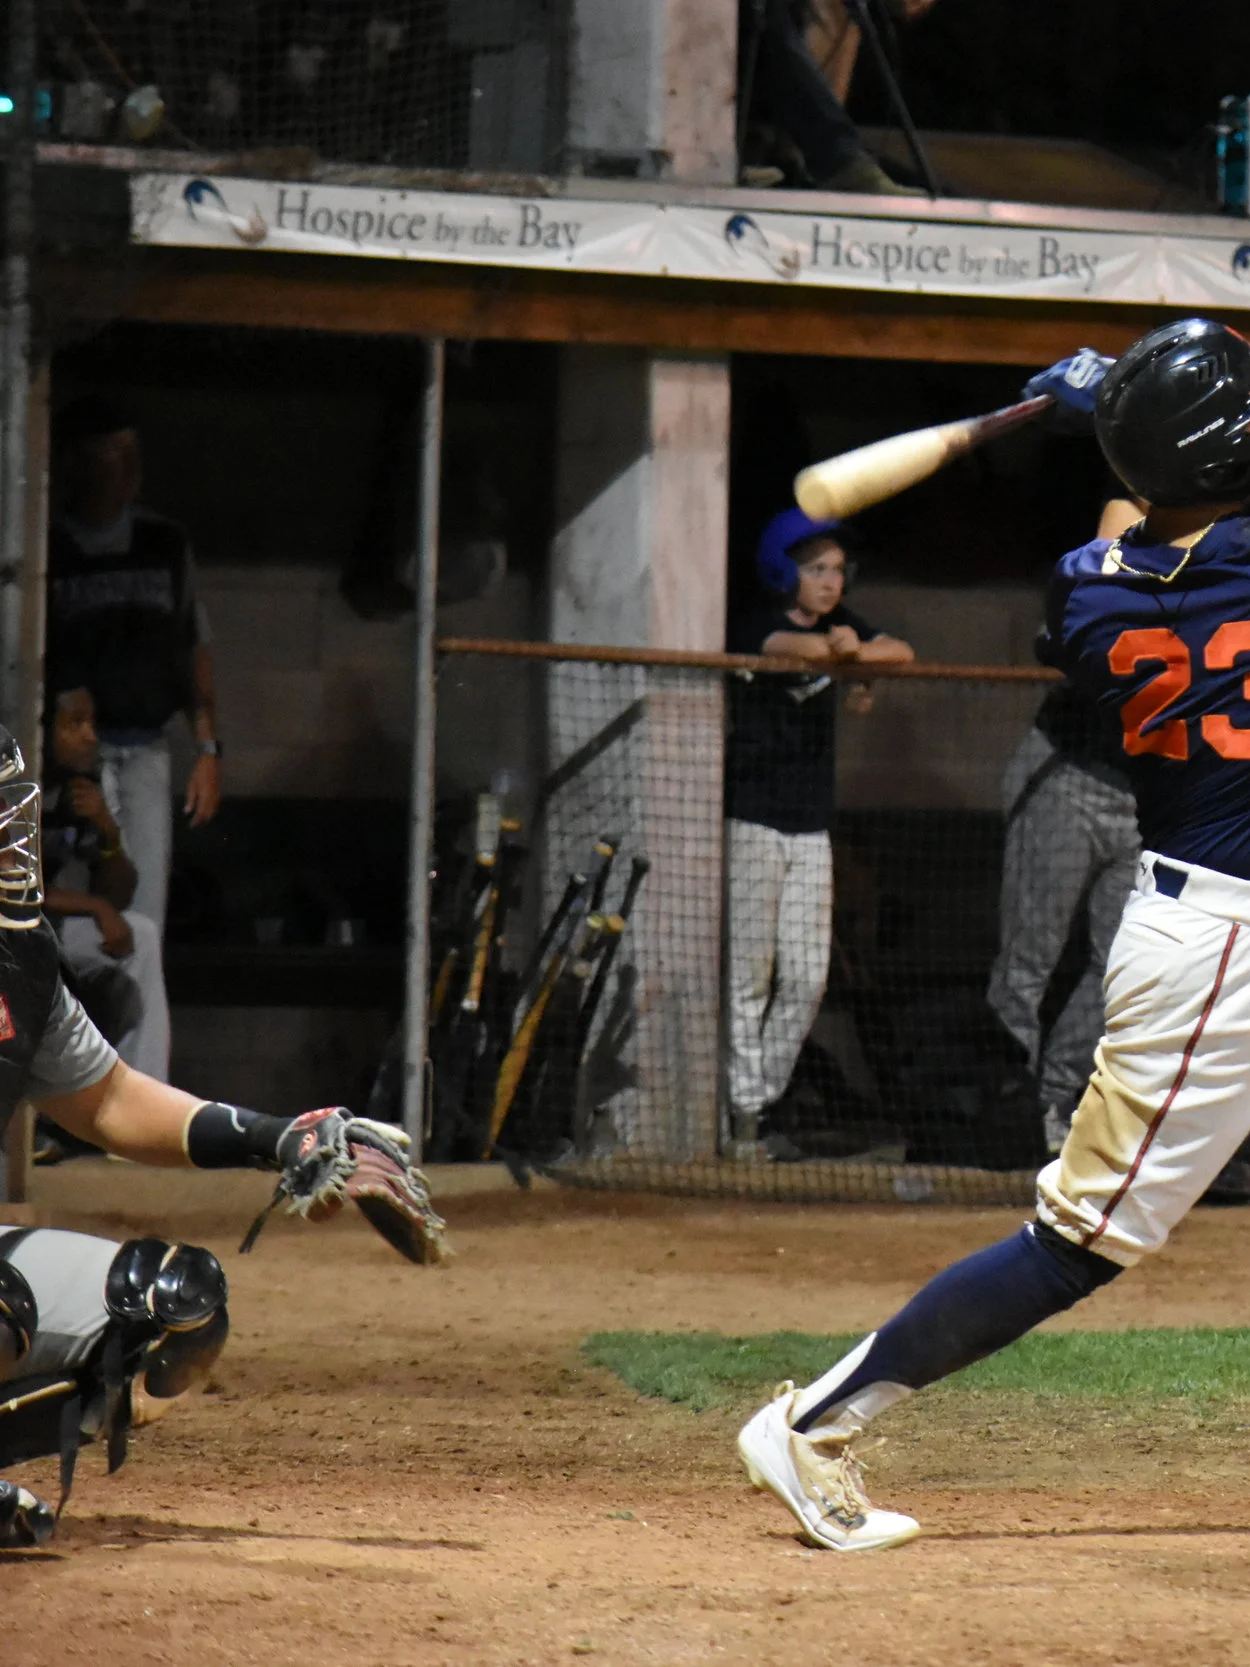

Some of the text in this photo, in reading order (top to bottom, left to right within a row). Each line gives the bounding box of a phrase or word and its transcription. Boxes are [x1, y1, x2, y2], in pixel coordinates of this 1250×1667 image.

[276, 188, 581, 262] Hospice by the Bay
[811, 222, 1100, 291] Hospice by the Bay
